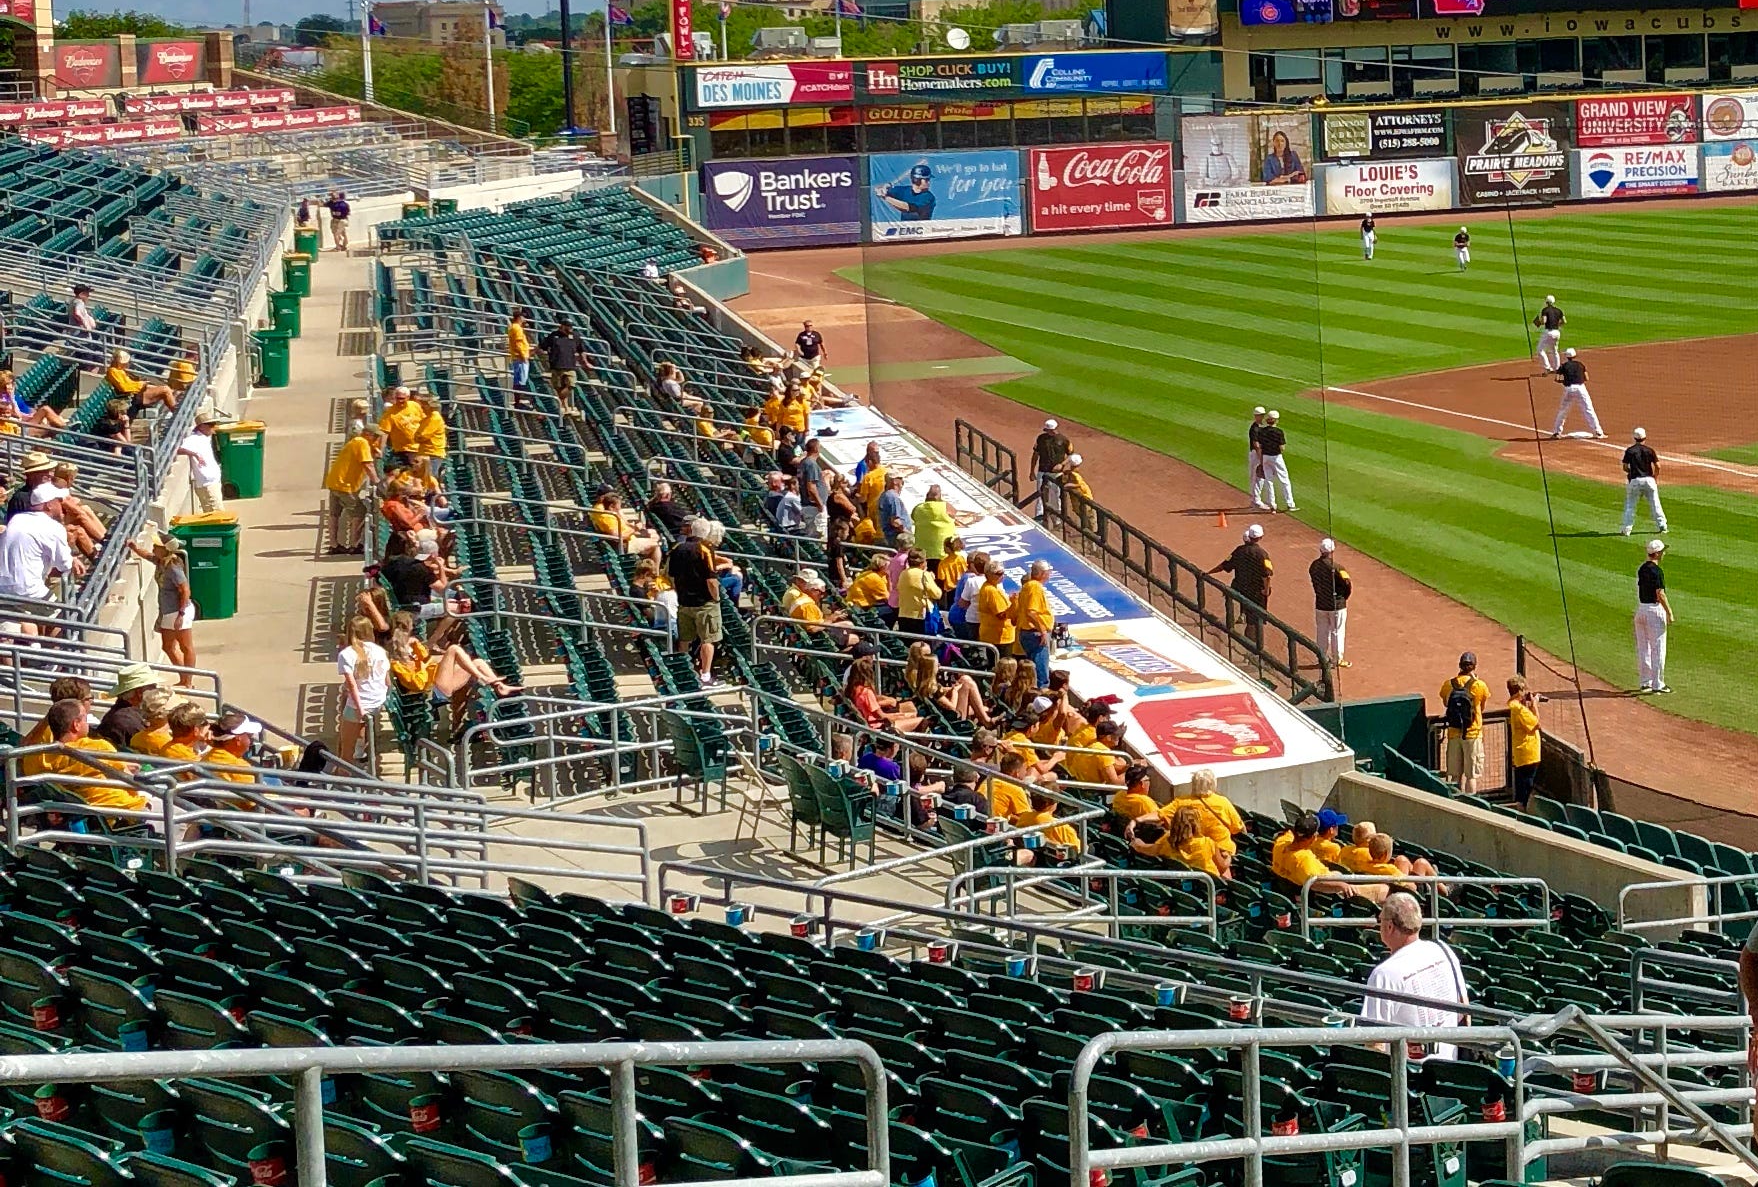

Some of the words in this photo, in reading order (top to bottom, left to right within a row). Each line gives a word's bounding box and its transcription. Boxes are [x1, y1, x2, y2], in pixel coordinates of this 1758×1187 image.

[678, 7, 690, 47] FOWL
[978, 63, 1011, 74] BUY!
[868, 69, 898, 91] Hm
[900, 76, 1012, 91] Homemakers.com
[702, 83, 728, 103] DES
[732, 81, 782, 102] MOINES
[868, 108, 935, 120] GOLDEN
[1581, 101, 1630, 118] GRAND
[1633, 99, 1668, 115] VIEW
[687, 117, 705, 127] 335
[1375, 114, 1442, 125] ATTORNEYS
[1583, 117, 1664, 134] UNIVERSITY
[1379, 139, 1400, 149] (515)
[1470, 159, 1510, 171] PRAIRIE
[1513, 155, 1564, 169] MEADOWS
[1625, 150, 1686, 164] RE/MAX
[965, 165, 977, 173] go
[992, 162, 1008, 172] bat
[1063, 149, 1168, 187] Coca-Cola
[1360, 165, 1419, 181] LOUIE'S
[1625, 165, 1687, 177] PRECISION
[760, 169, 852, 191] Bankers
[951, 176, 975, 200] for
[1225, 189, 1247, 198] FARM
[1250, 188, 1281, 197] BUREAU
[1345, 185, 1377, 197] Floor
[1380, 183, 1434, 197] Covering
[1225, 197, 1268, 207] FINANCIAL
[1269, 195, 1306, 205] SERVICES
[1041, 206, 1049, 216] a
[1051, 202, 1069, 215] hit
[1070, 203, 1103, 217] every
[1104, 201, 1131, 213] time
[899, 227, 924, 236] EMC
